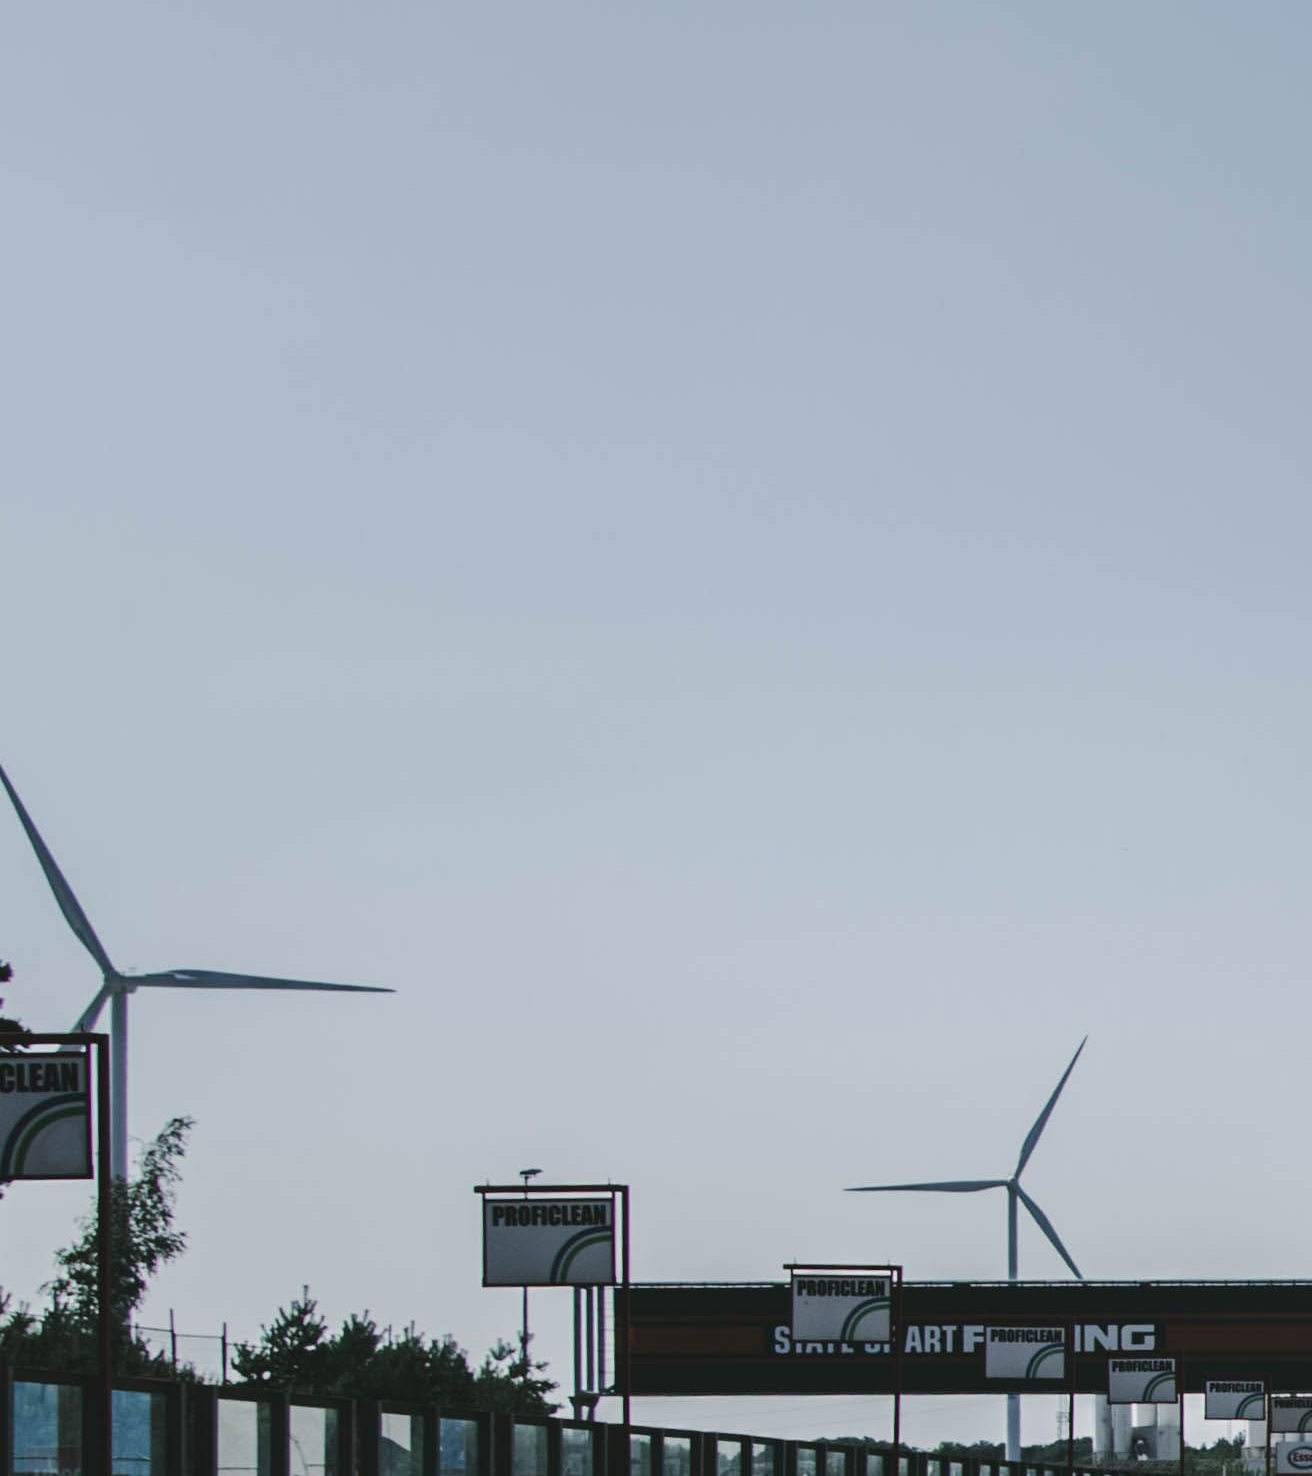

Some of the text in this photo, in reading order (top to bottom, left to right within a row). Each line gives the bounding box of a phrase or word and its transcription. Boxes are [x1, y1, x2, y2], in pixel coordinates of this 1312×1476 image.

[492, 1204, 607, 1227] PROFICLEAN
[796, 1279, 886, 1297] PROFICLEAN
[904, 1326, 957, 1353] ART
[990, 1327, 1062, 1343] PROFICLEAN
[1111, 1360, 1173, 1373] PROFICLEAN
[1209, 1382, 1262, 1394] PROFICLEAN
